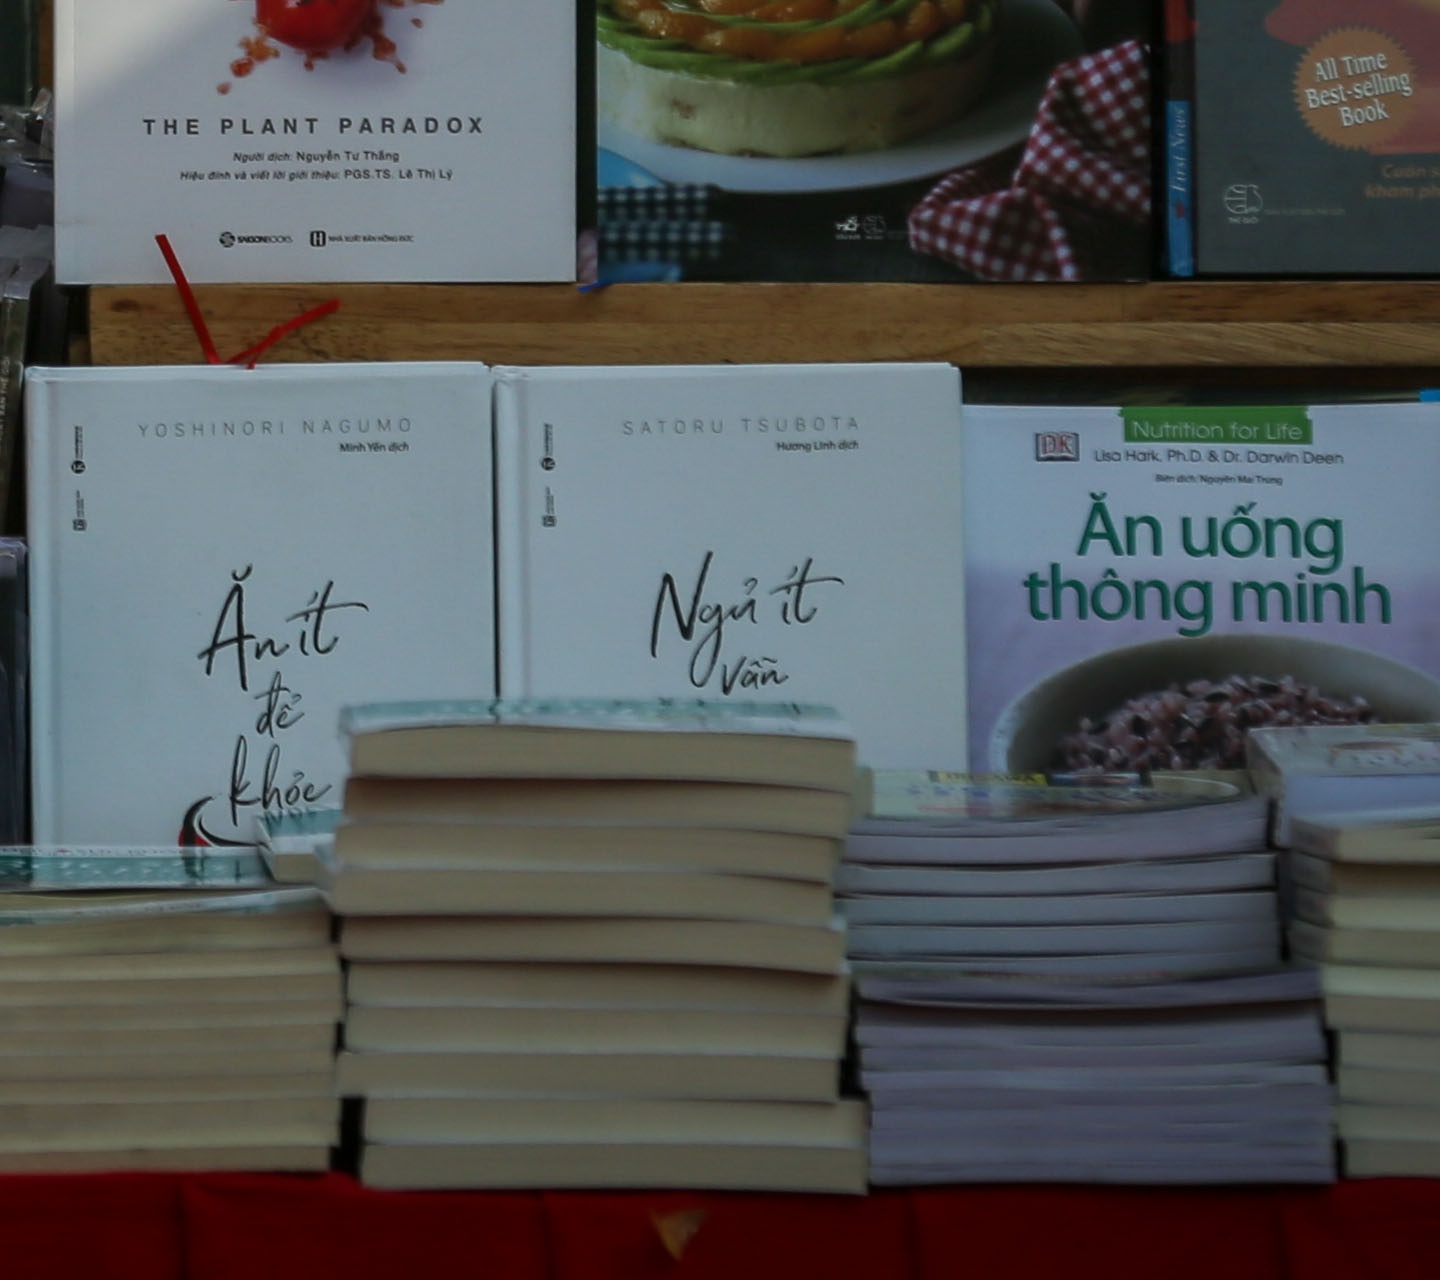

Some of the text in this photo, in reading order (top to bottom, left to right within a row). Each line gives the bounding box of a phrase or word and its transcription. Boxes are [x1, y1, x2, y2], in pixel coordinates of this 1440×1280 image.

[143, 117, 484, 135] THE PLANT PARADOX
[137, 418, 413, 438] YOSHINORI NAGUMO
[623, 416, 860, 436] SATORU TSUBOTA
[1077, 492, 1343, 574] Ăn uống
[770, 557, 844, 624] ít
[1024, 563, 1391, 637] thông minh
[198, 564, 369, 691] Ăn ít
